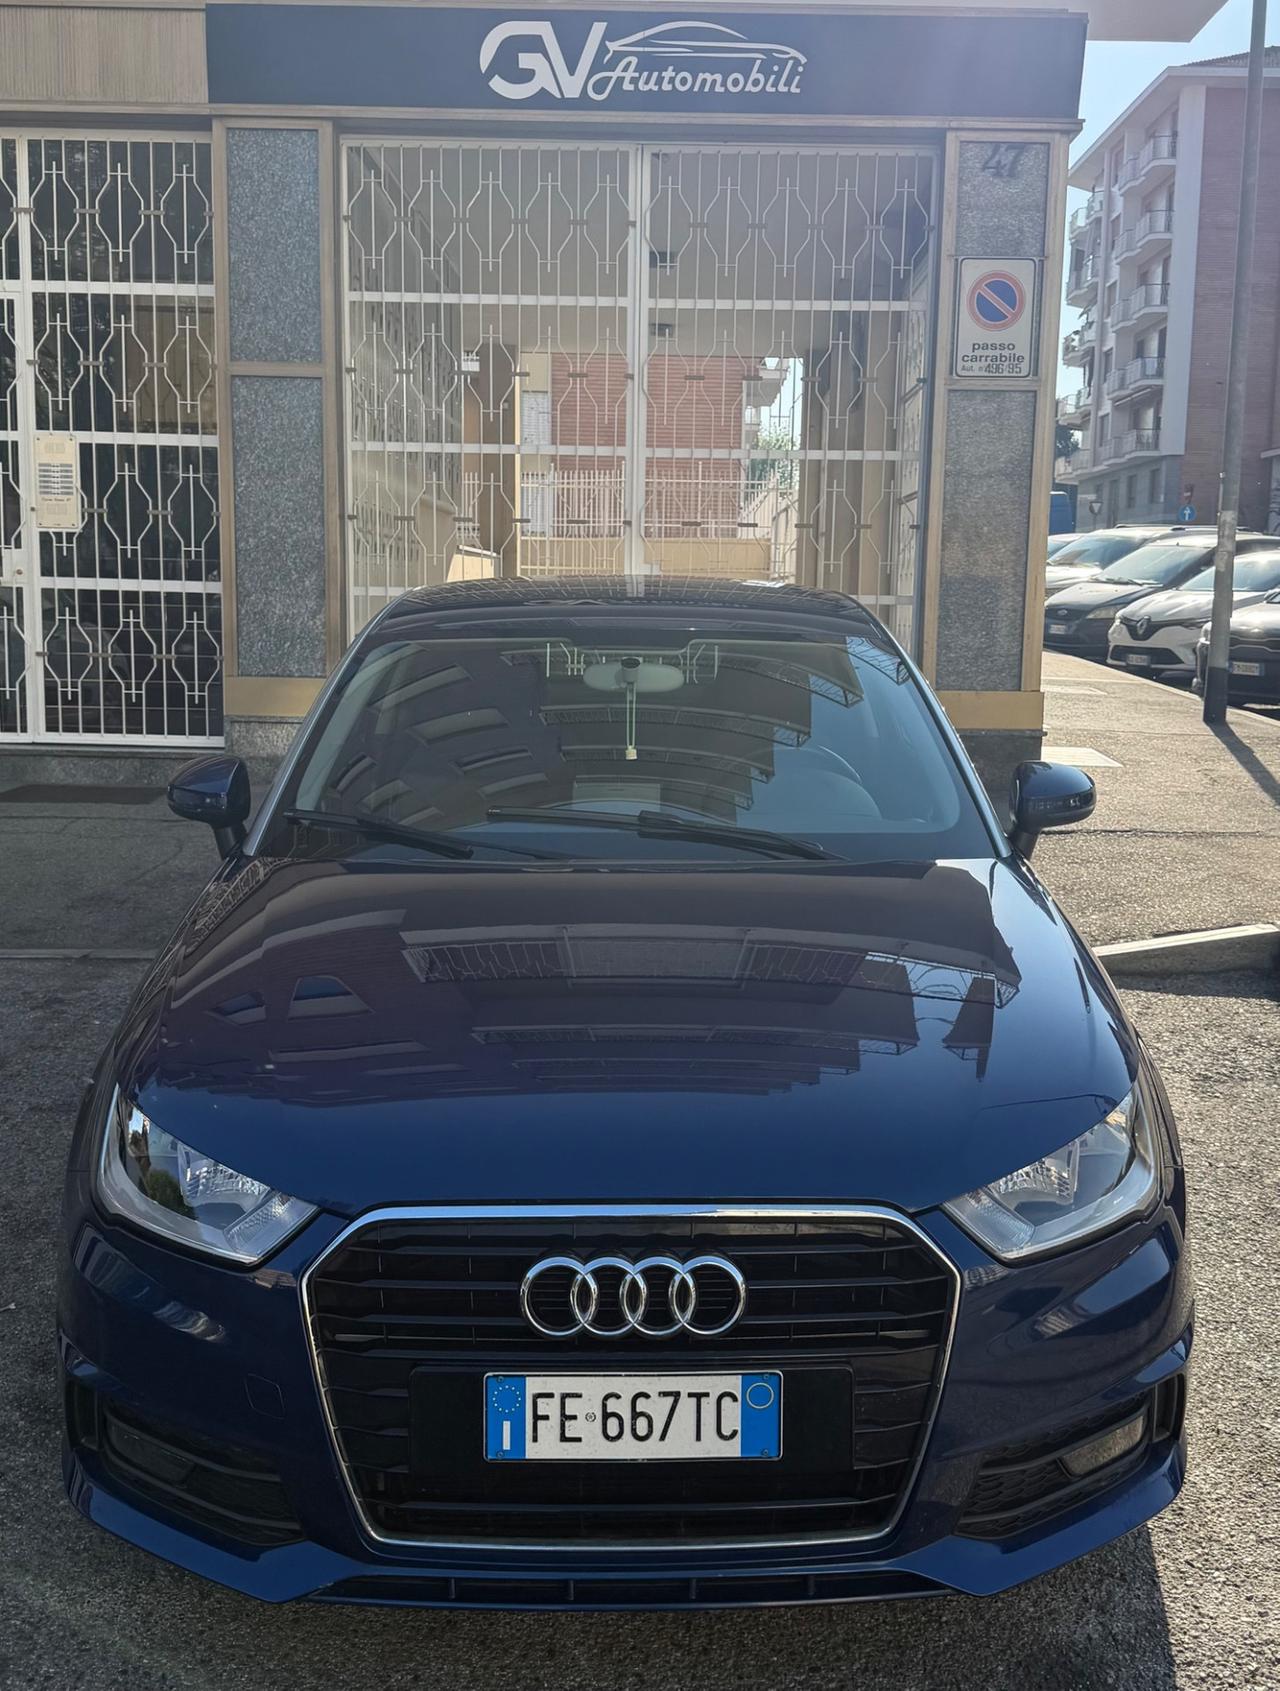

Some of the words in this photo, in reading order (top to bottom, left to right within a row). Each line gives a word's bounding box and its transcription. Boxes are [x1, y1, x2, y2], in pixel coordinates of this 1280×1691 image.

[479, 21, 608, 99] GV
[587, 56, 805, 101] Automobili
[982, 143, 1025, 177] 47
[961, 353, 1024, 363] carrabile
[972, 343, 1015, 353] passo
